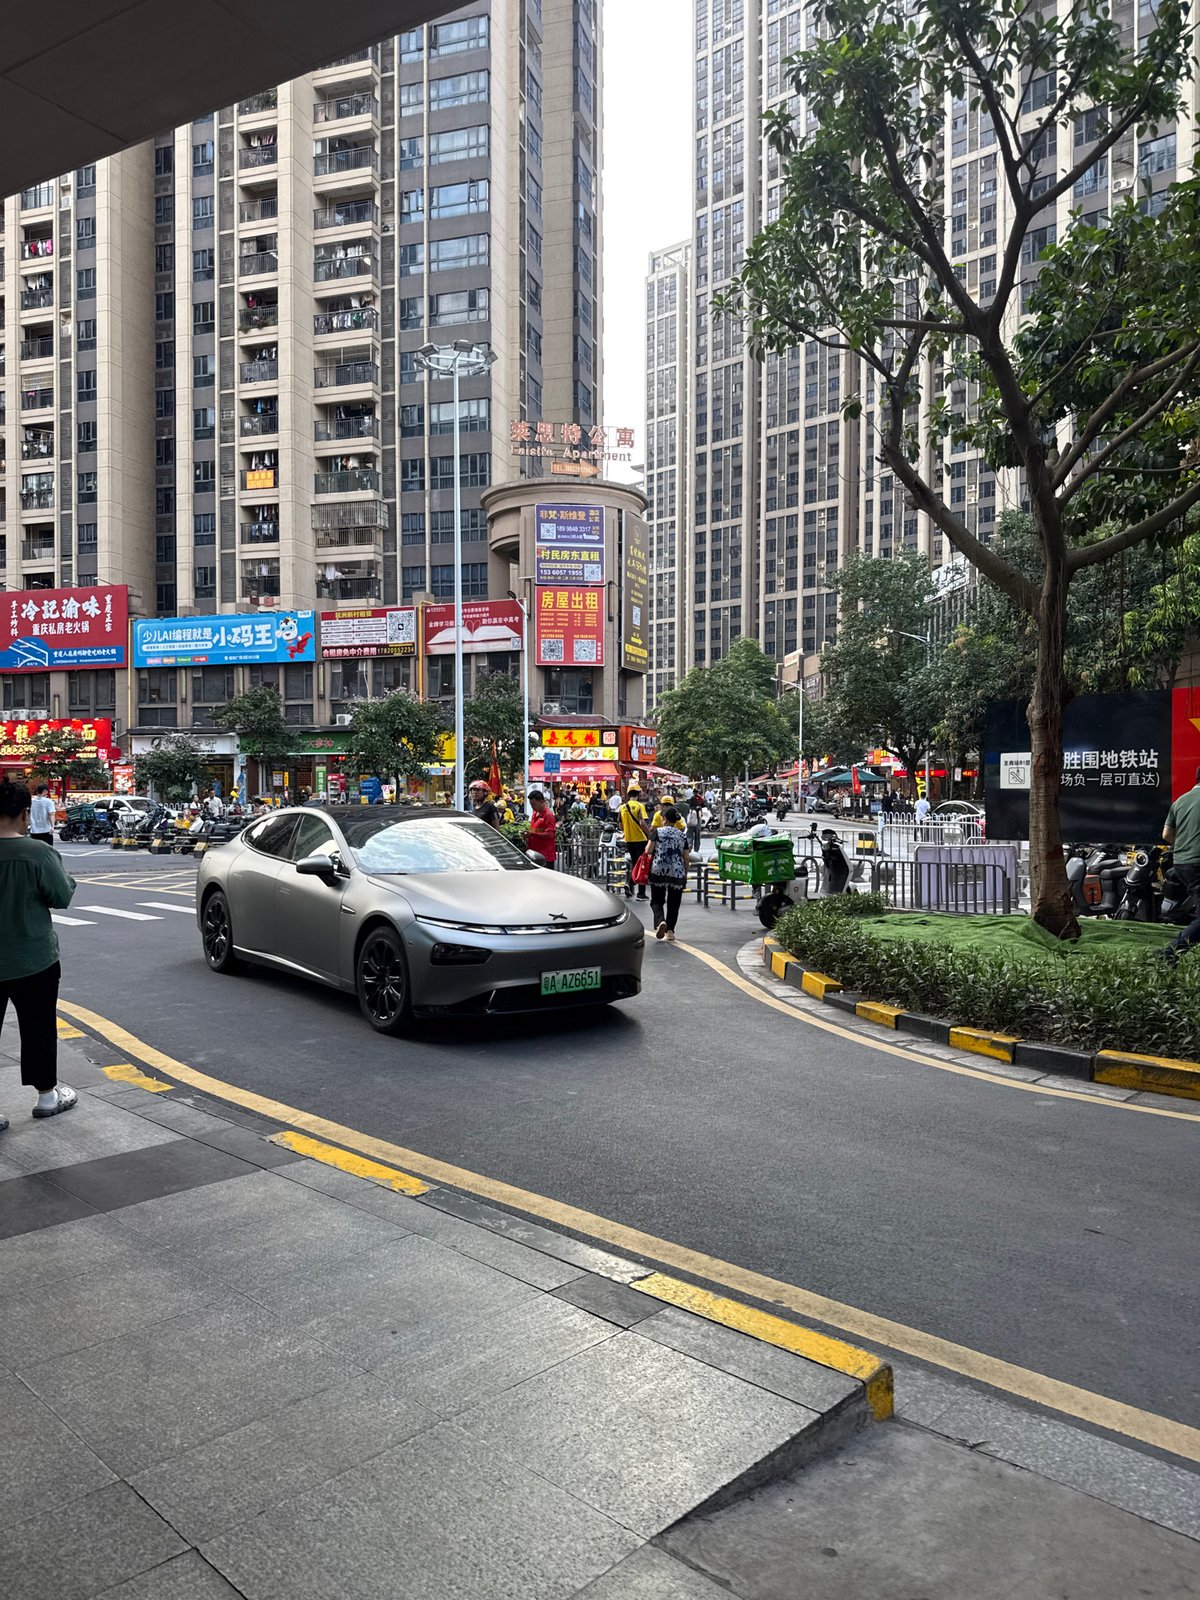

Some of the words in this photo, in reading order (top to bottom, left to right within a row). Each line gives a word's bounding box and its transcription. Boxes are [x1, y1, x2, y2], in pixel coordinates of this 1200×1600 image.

[563, 447, 631, 461] Apartment
[541, 550, 600, 561] 村民房东直租
[21, 595, 101, 621] 冷記渝味
[542, 591, 598, 609] 房屋出租
[32, 620, 90, 636] 重庆私房老火锅
[142, 627, 212, 642] 少儿AI编程就是
[212, 624, 272, 648] 小码王
[562, 970, 598, 990] AZ6651
